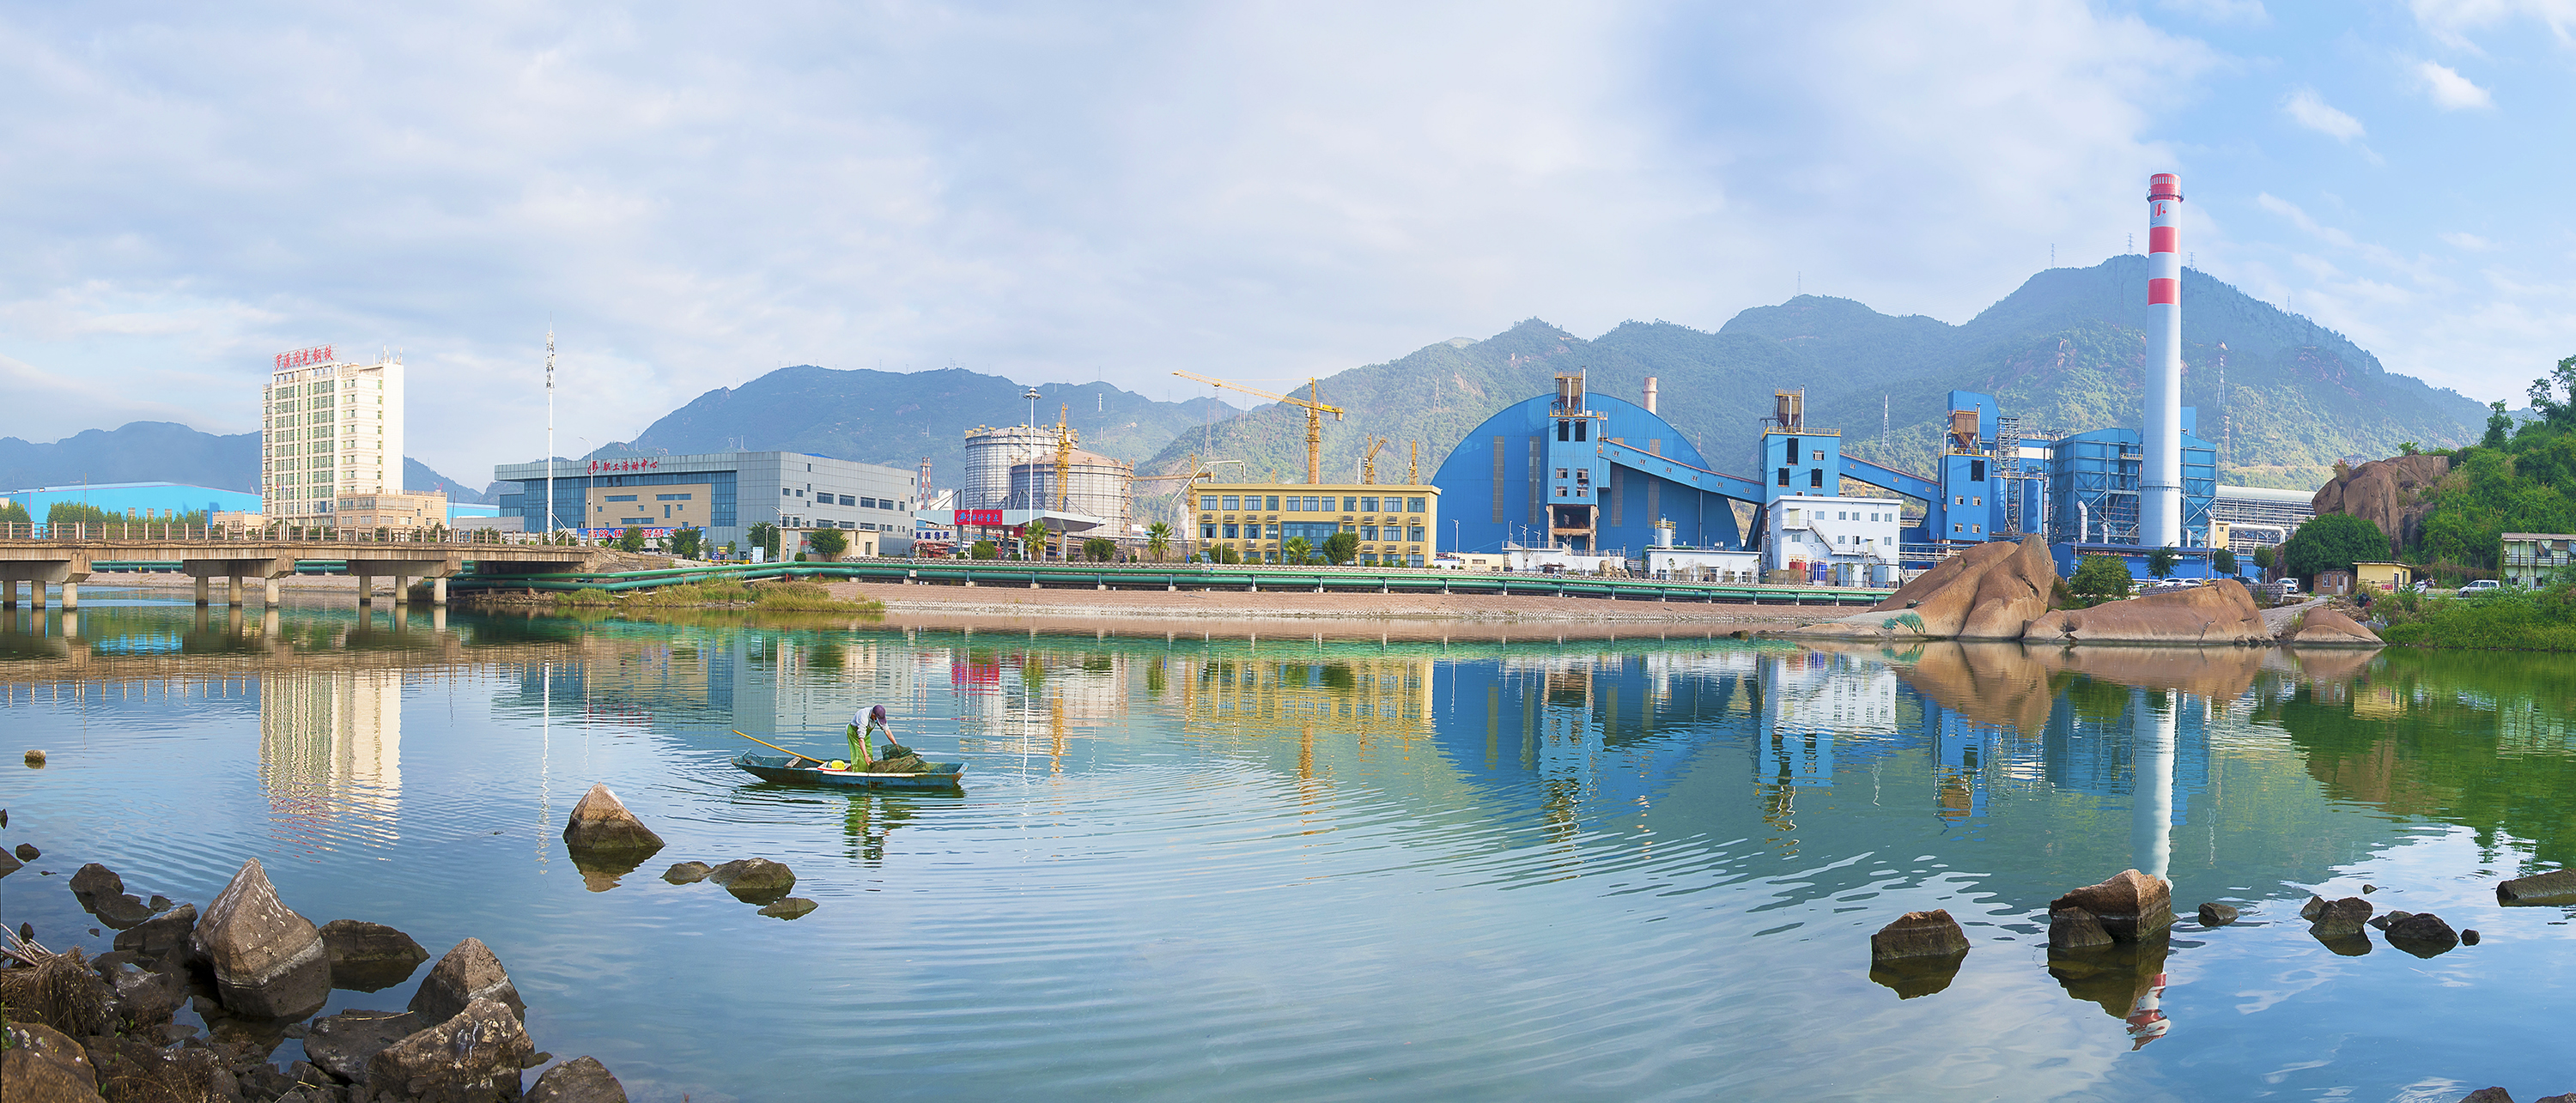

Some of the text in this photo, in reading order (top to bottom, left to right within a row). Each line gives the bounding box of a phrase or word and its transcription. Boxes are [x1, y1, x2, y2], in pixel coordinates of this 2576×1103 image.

[603, 458, 658, 472] 职工活动中心
